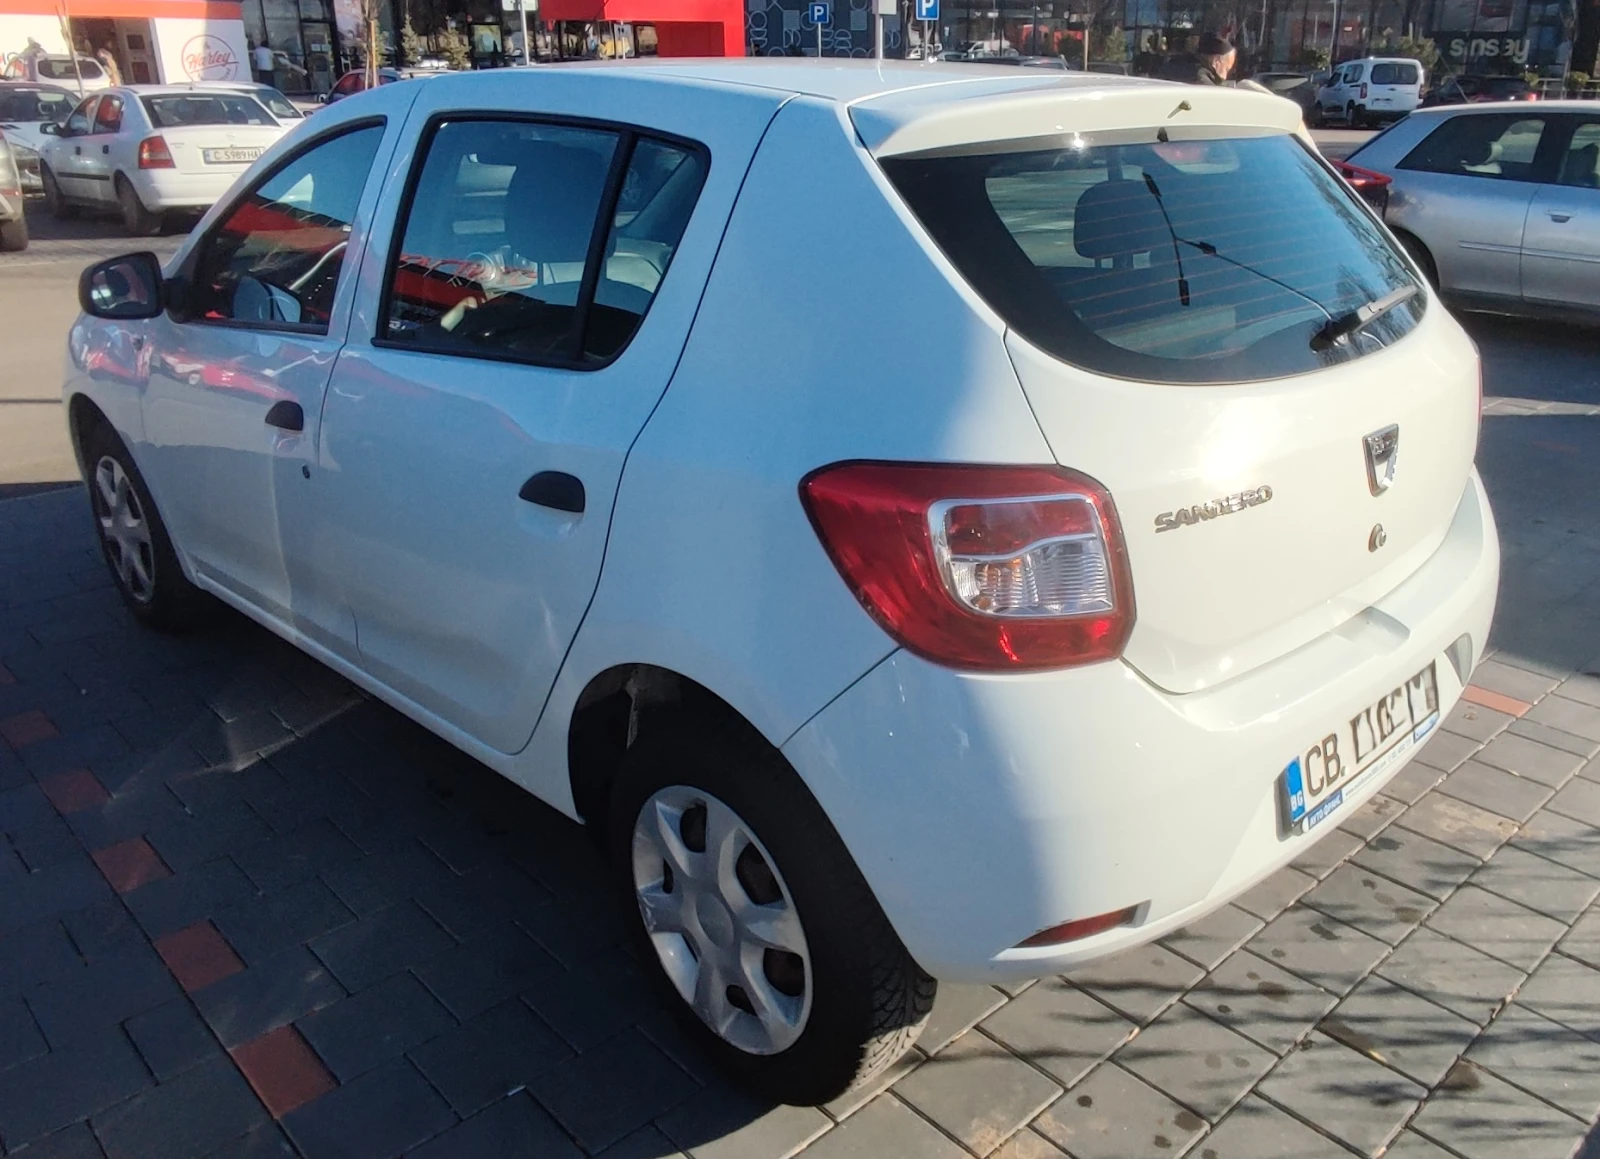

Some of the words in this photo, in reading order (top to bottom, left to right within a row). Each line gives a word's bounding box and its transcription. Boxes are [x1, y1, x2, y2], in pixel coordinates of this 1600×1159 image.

[814, 5, 825, 20] P
[921, 0, 934, 16] P
[185, 50, 232, 69] Harley
[1290, 789, 1304, 812] BG
